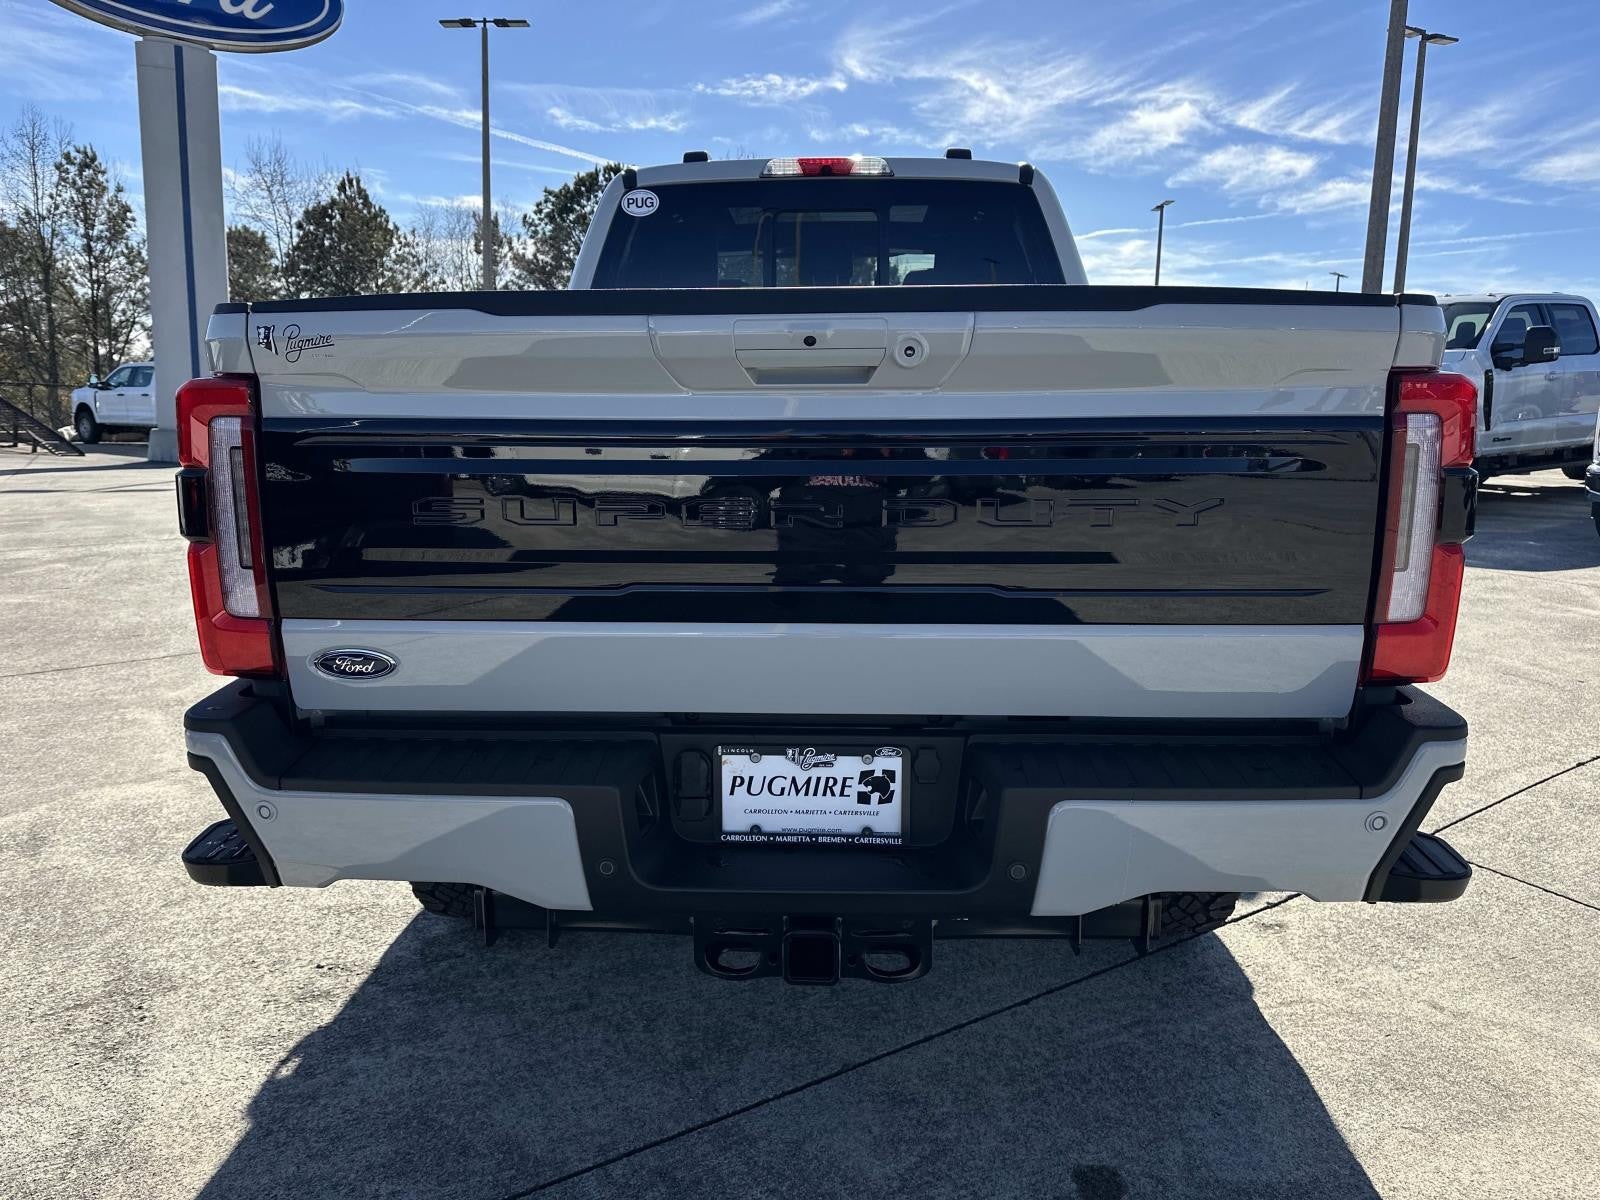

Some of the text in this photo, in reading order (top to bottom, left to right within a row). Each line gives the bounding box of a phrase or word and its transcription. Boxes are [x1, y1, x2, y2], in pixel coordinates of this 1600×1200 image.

[627, 197, 654, 208] PUG
[282, 323, 335, 363] Pugmire
[411, 496, 1225, 528] SUPER DUTY
[333, 655, 376, 673] Ford
[802, 747, 837, 770] Pugmire
[729, 775, 853, 797] PUGMIRE
[833, 809, 880, 817] CARTERSVILLE
[721, 834, 903, 845] CARROLLTON MARIETTA BREMEN CARTERSVILLE
